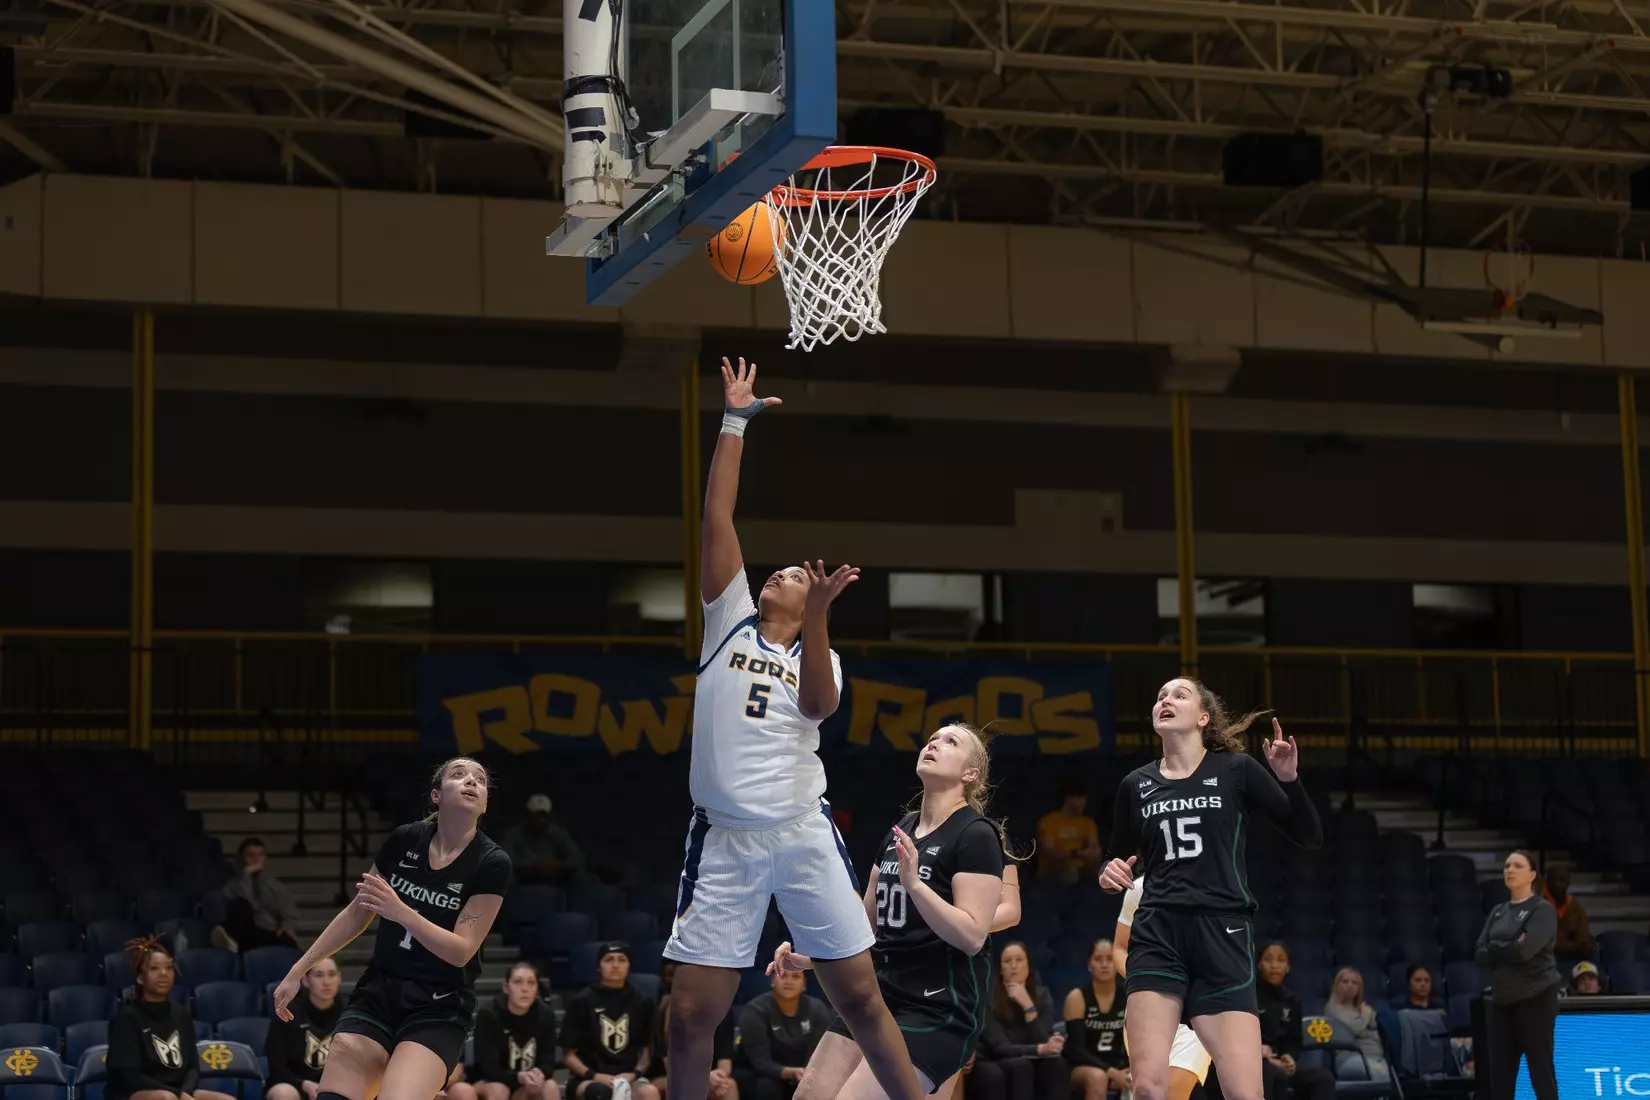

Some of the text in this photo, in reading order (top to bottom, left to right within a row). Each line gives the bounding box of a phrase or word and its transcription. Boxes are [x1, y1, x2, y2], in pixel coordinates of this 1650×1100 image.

[745, 682, 772, 719] 5
[1141, 796, 1222, 818] VIKINGS
[1159, 816, 1203, 861] 15
[390, 873, 461, 910] VIKINGS
[876, 881, 907, 929] 20
[1097, 1031, 1115, 1052] 2
